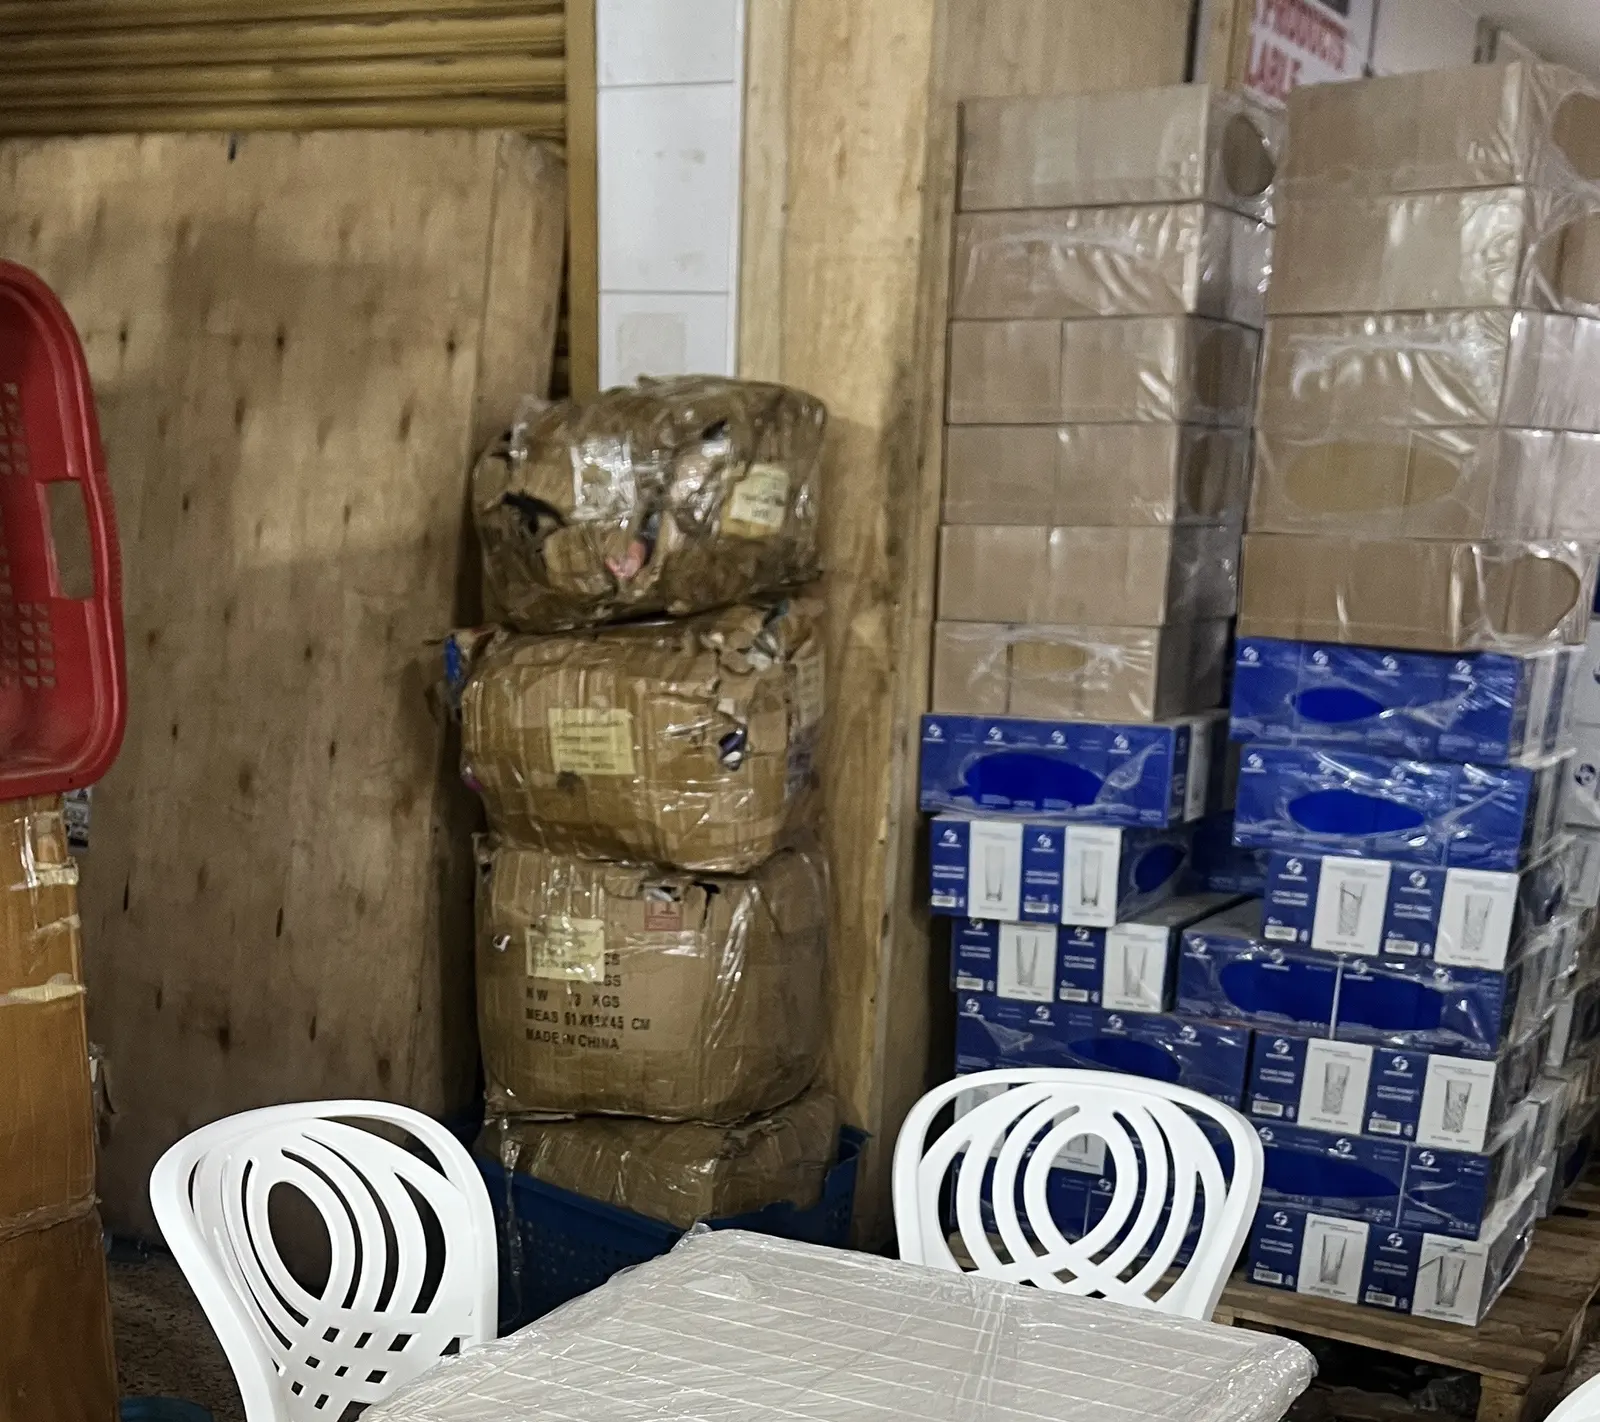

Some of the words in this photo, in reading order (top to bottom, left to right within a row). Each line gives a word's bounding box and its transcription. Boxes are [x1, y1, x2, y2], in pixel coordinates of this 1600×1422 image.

[525, 1007, 559, 1024] MEAS
[525, 1027, 560, 1045] MADE
[562, 1033, 577, 1046] IN
[578, 1033, 620, 1050] CHINA
